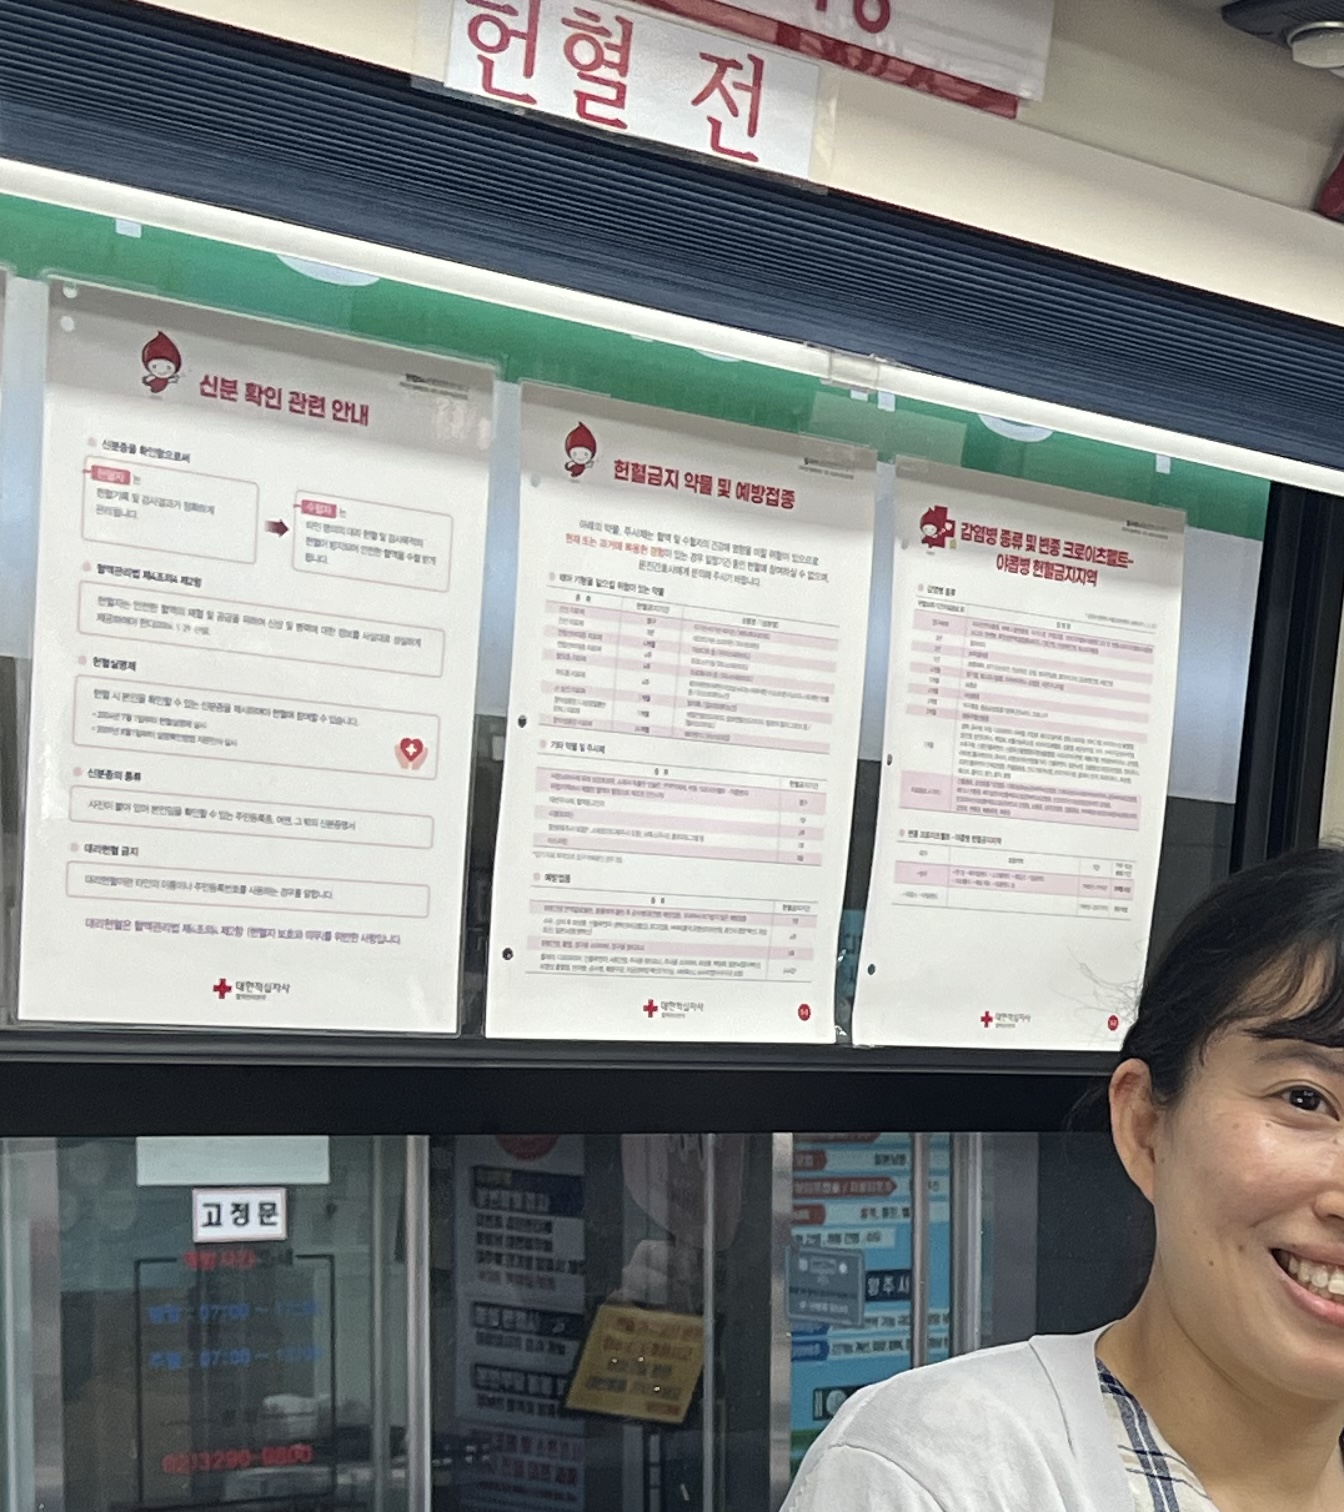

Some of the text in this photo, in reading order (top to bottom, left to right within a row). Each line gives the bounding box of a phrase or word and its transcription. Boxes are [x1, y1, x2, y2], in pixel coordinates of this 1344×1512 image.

[467, 0, 763, 163] 헌혈 전
[199, 373, 369, 427] 신분 확인 관련 안내
[613, 459, 795, 510] 헌혈금지 약물 및 예방접종
[960, 522, 998, 545] 감염병
[1000, 530, 1023, 550] 종류
[1026, 534, 1037, 553] 및
[1039, 537, 1061, 557] 변종
[996, 553, 1098, 588] 야콥병 헌혈금지지역
[200, 1201, 281, 1228] 고정문
